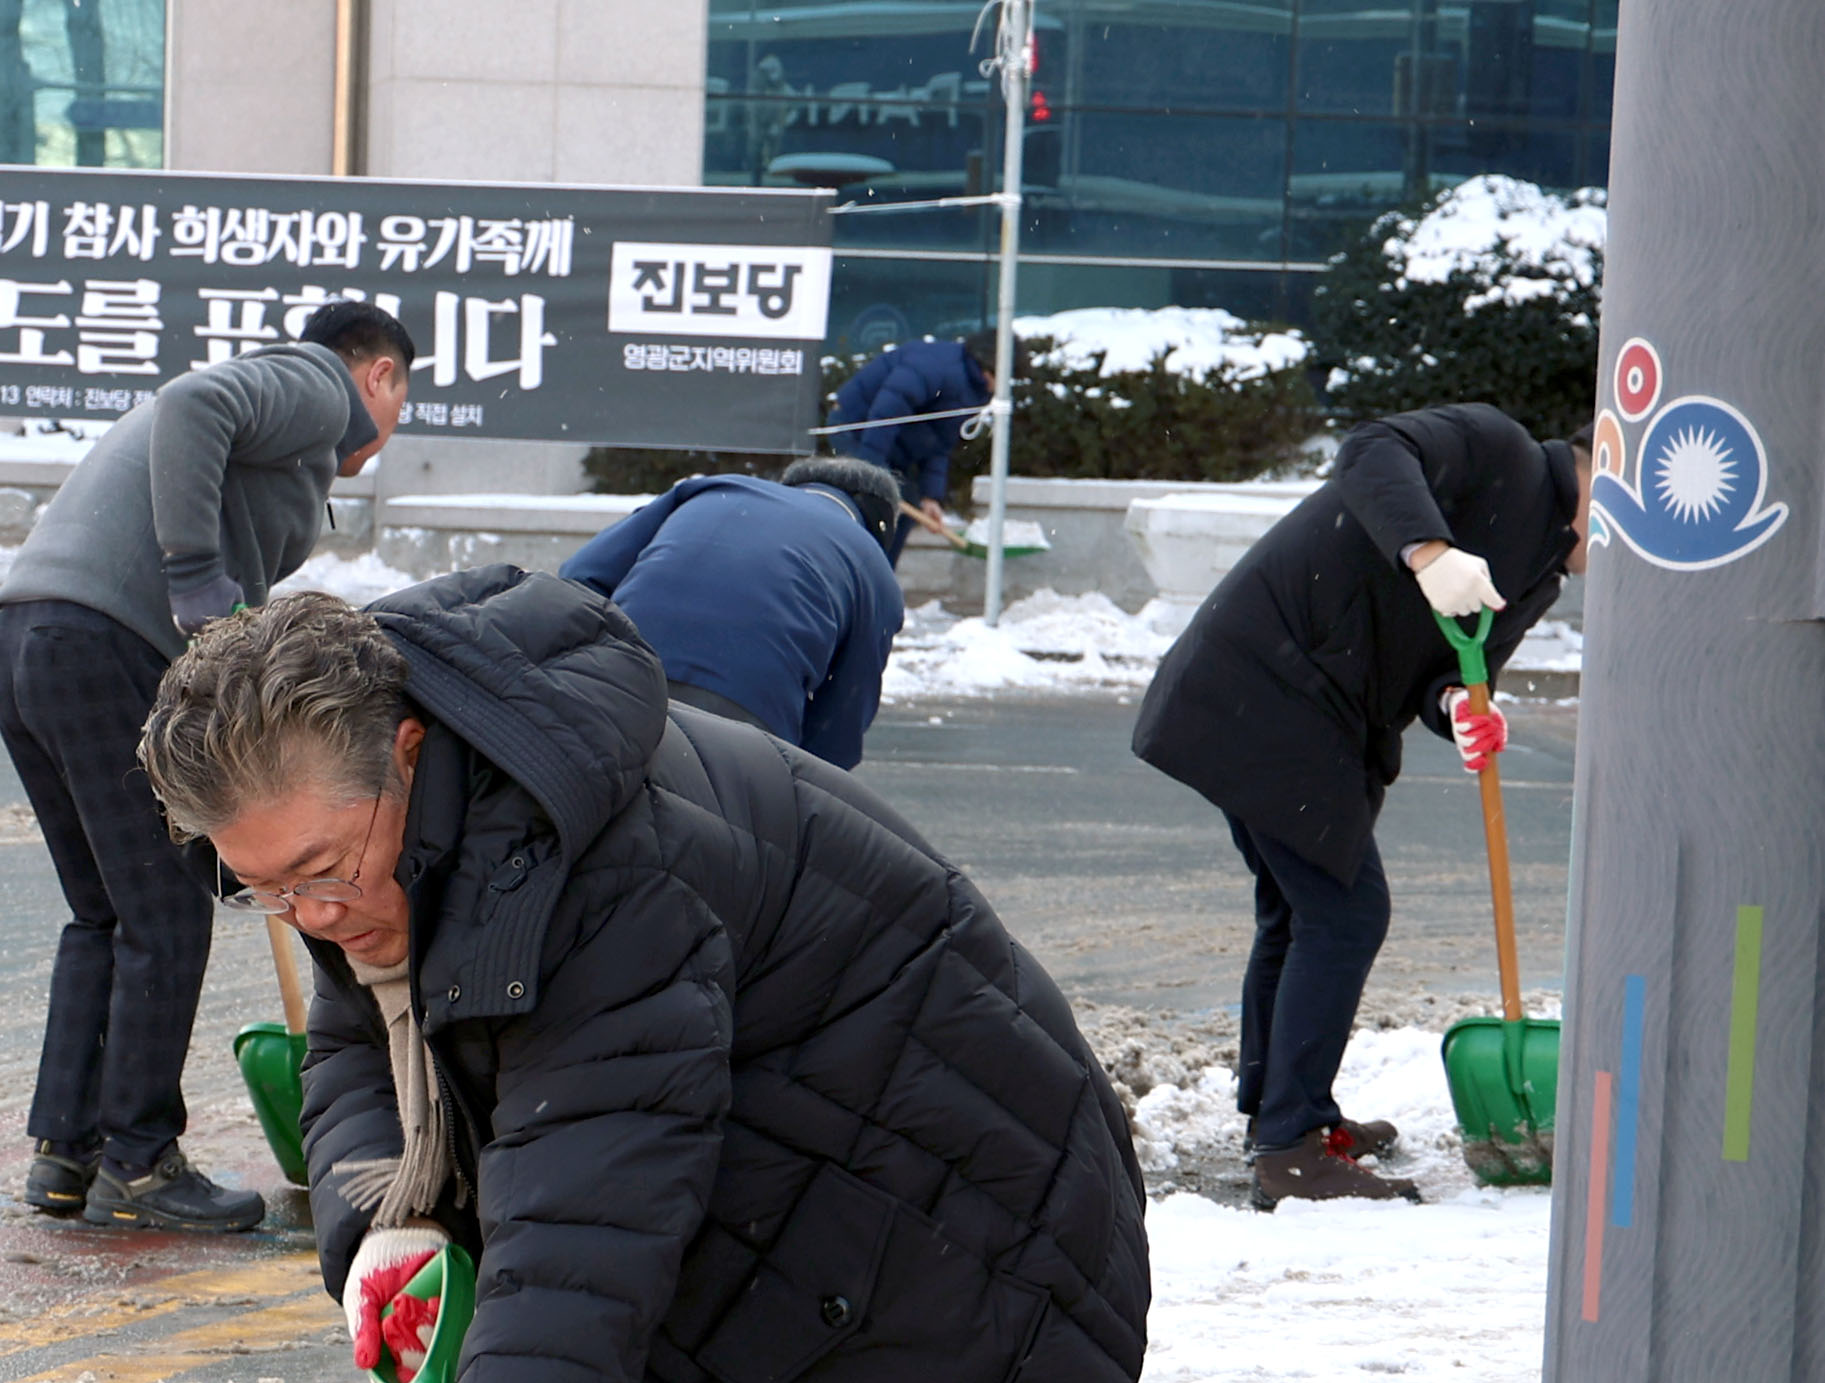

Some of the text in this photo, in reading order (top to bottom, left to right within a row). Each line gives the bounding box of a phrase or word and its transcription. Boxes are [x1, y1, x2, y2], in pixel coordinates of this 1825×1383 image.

[62, 201, 162, 261] 참사
[169, 206, 367, 269] 희생자와
[376, 215, 574, 277] 유가족께
[632, 261, 803, 320] 진보당
[623, 343, 804, 375] 영광군지역위원회
[84, 387, 133, 412] 진보당
[415, 402, 448, 426] 직접
[450, 404, 483, 427] 설치
